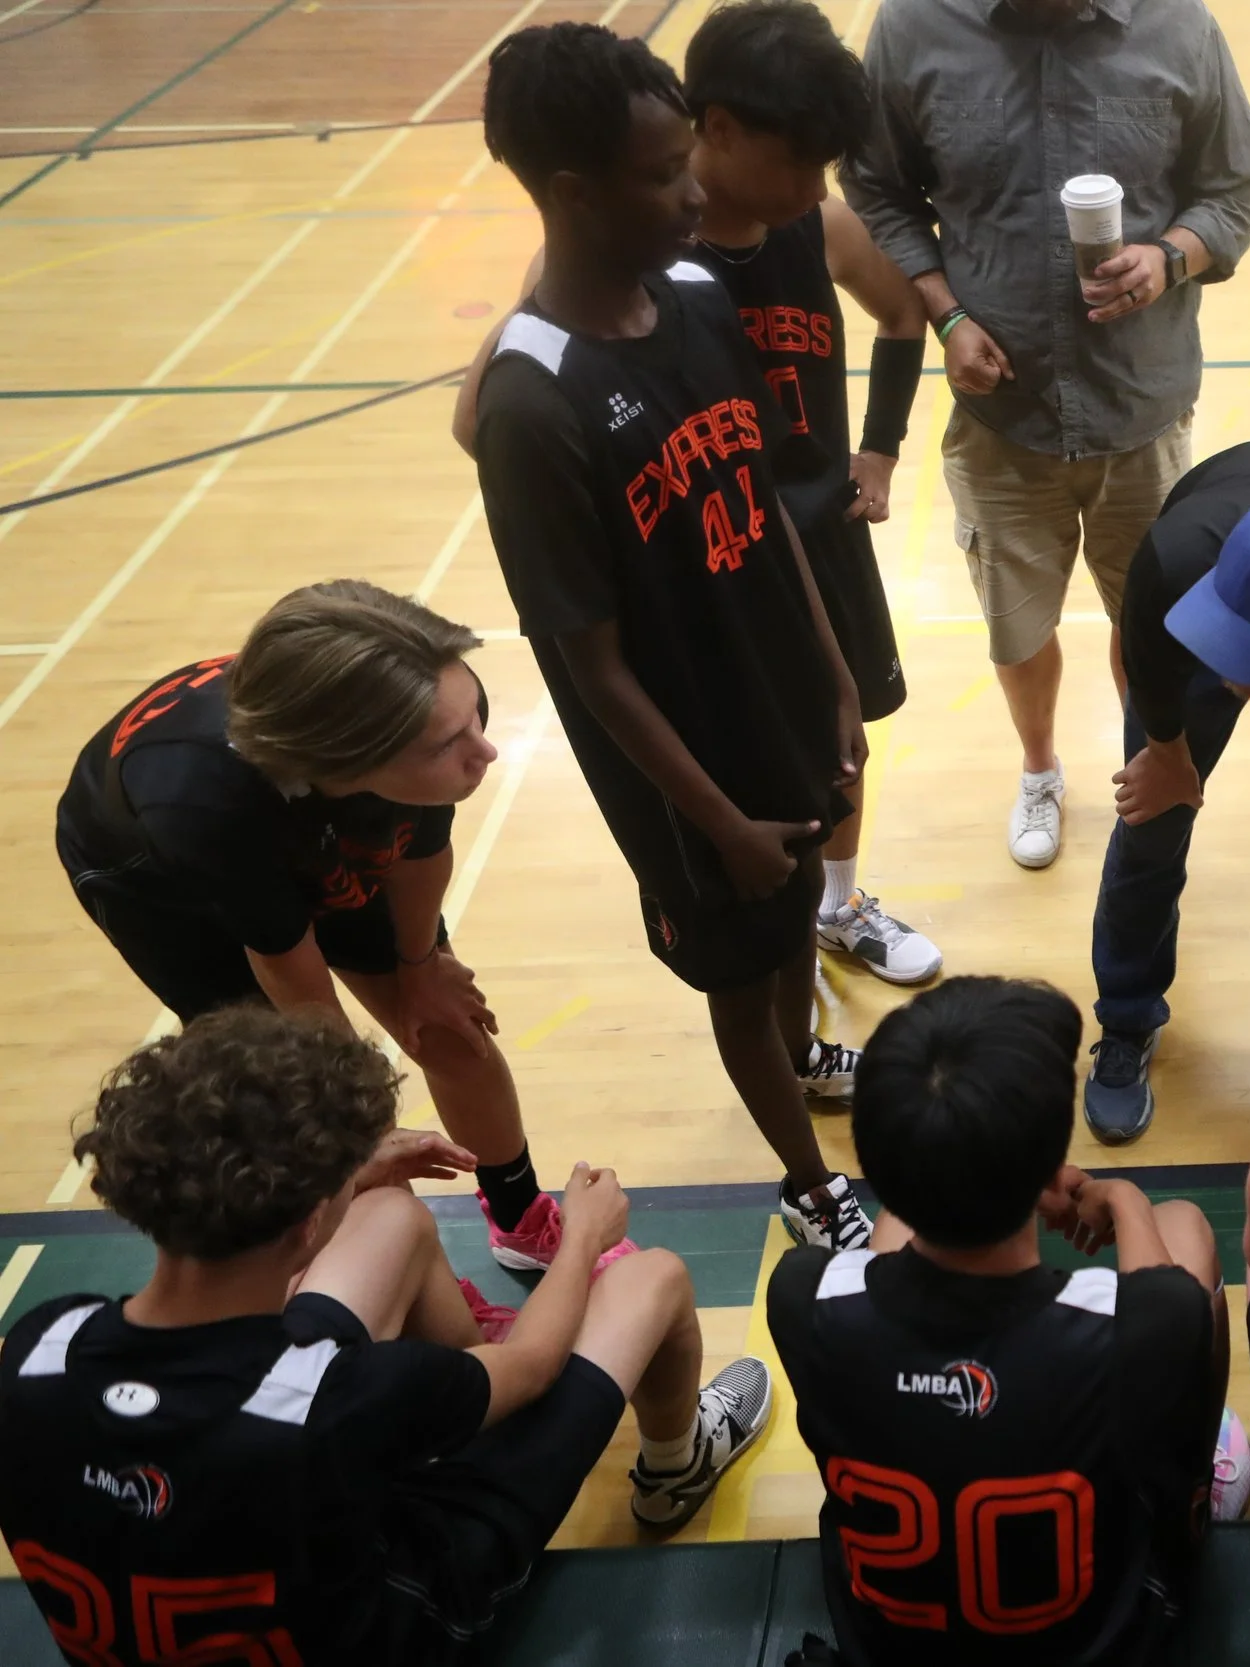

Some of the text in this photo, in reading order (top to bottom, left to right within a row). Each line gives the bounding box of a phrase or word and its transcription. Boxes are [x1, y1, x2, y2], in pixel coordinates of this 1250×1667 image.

[607, 401, 644, 432] XEIST
[626, 398, 762, 543] EXPRESS
[896, 1372, 962, 1395] LMBA
[83, 1463, 139, 1499] LMBA
[827, 1455, 1095, 1635] 20
